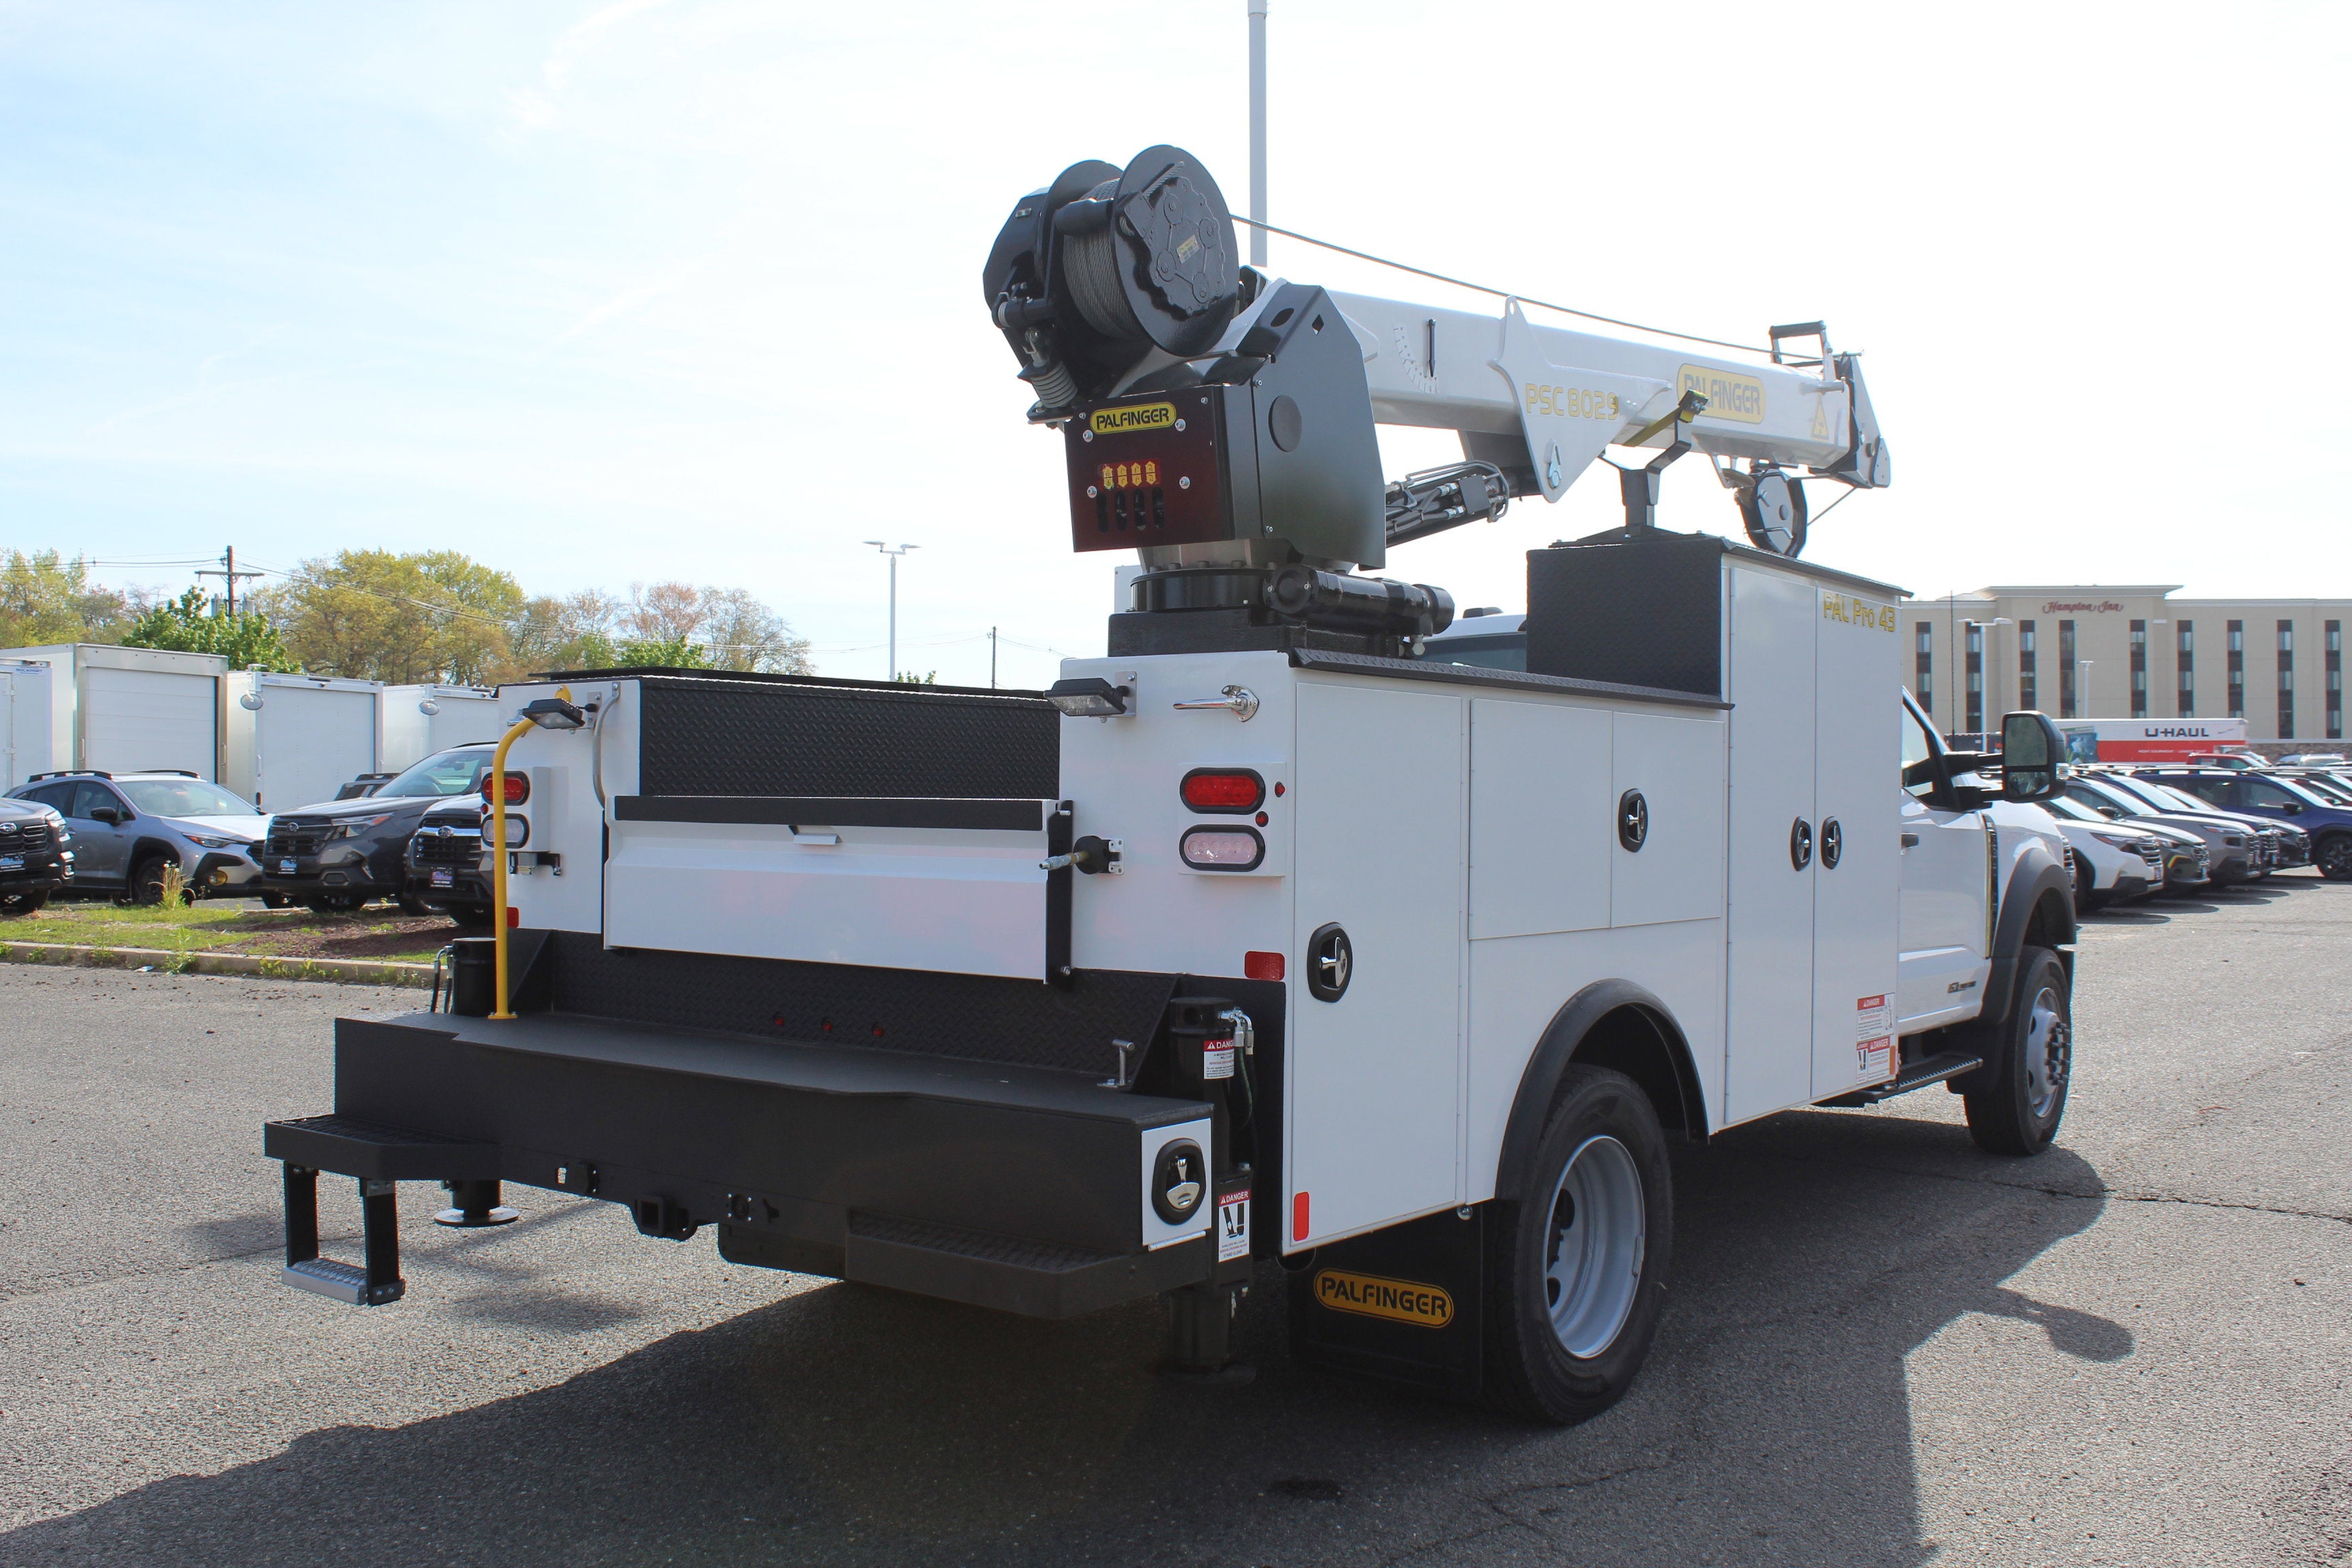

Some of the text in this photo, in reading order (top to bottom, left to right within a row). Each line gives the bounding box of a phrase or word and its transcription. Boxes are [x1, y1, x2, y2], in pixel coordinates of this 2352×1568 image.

[1526, 383, 1619, 421] PSC 8029
[1096, 408, 1169, 430] PALFINGER
[1823, 592, 1895, 632] PAL Pro 43
[2042, 600, 2123, 613] Hampton Inn
[2145, 728, 2209, 737] U-HAUL
[1873, 1038, 1889, 1049] DANGER
[1226, 1191, 1248, 1203] DANGER
[1322, 1277, 1447, 1318] PALFINGER
